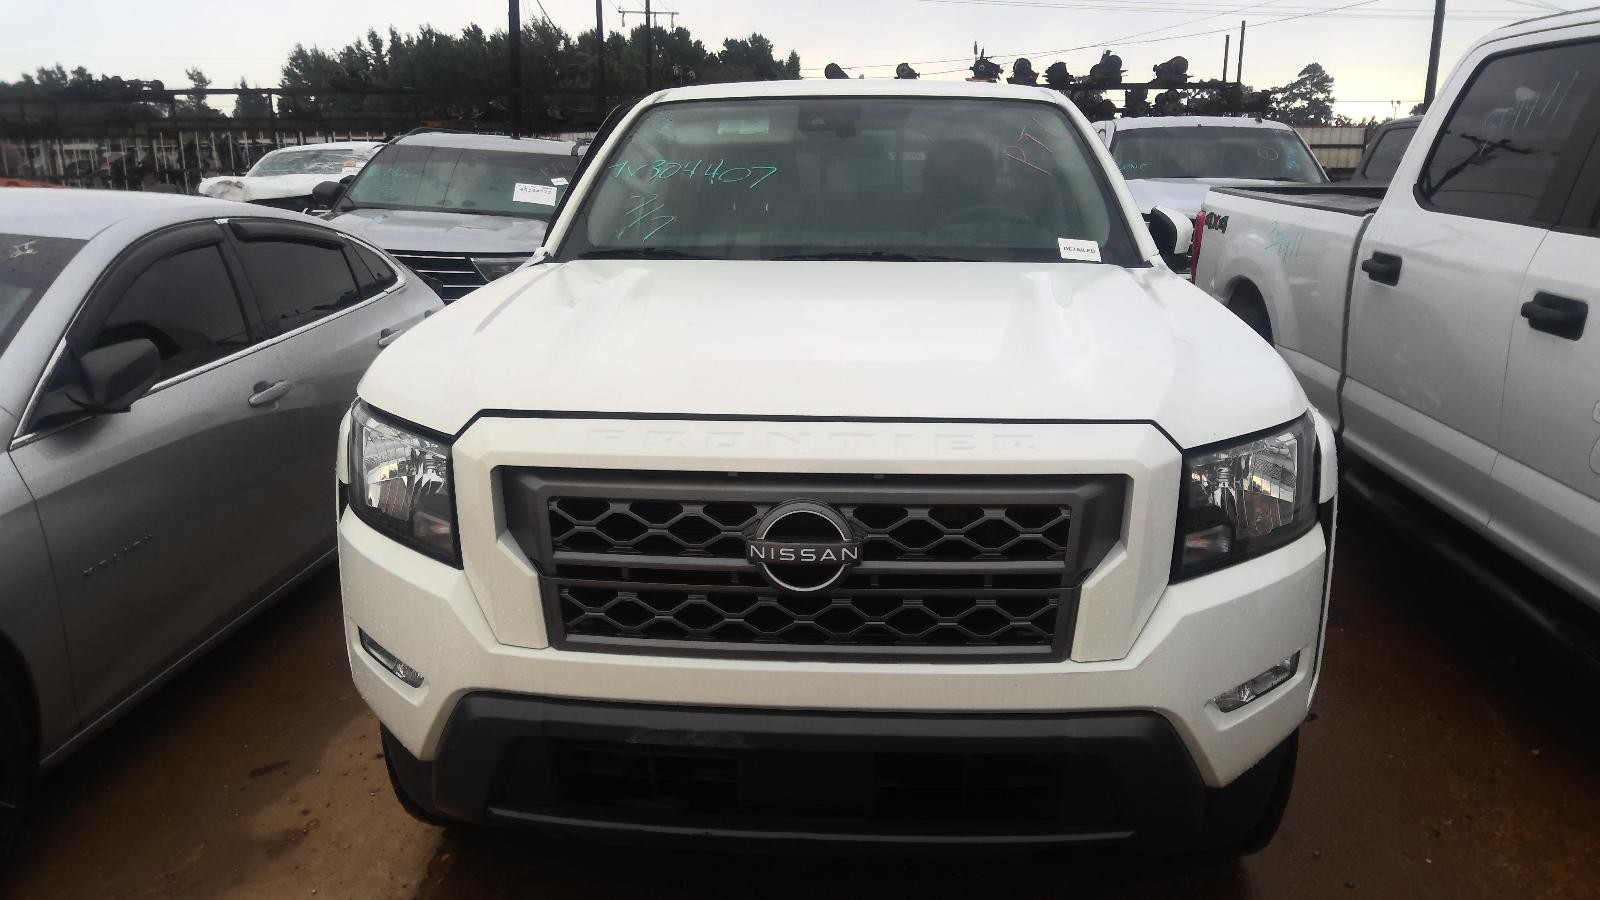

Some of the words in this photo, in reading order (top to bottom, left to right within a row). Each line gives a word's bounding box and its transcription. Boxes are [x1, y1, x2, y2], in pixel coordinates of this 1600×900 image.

[1063, 246, 1096, 254] DETAILED
[585, 429, 1042, 454] FRONTIER
[749, 543, 859, 563] NISSAN
